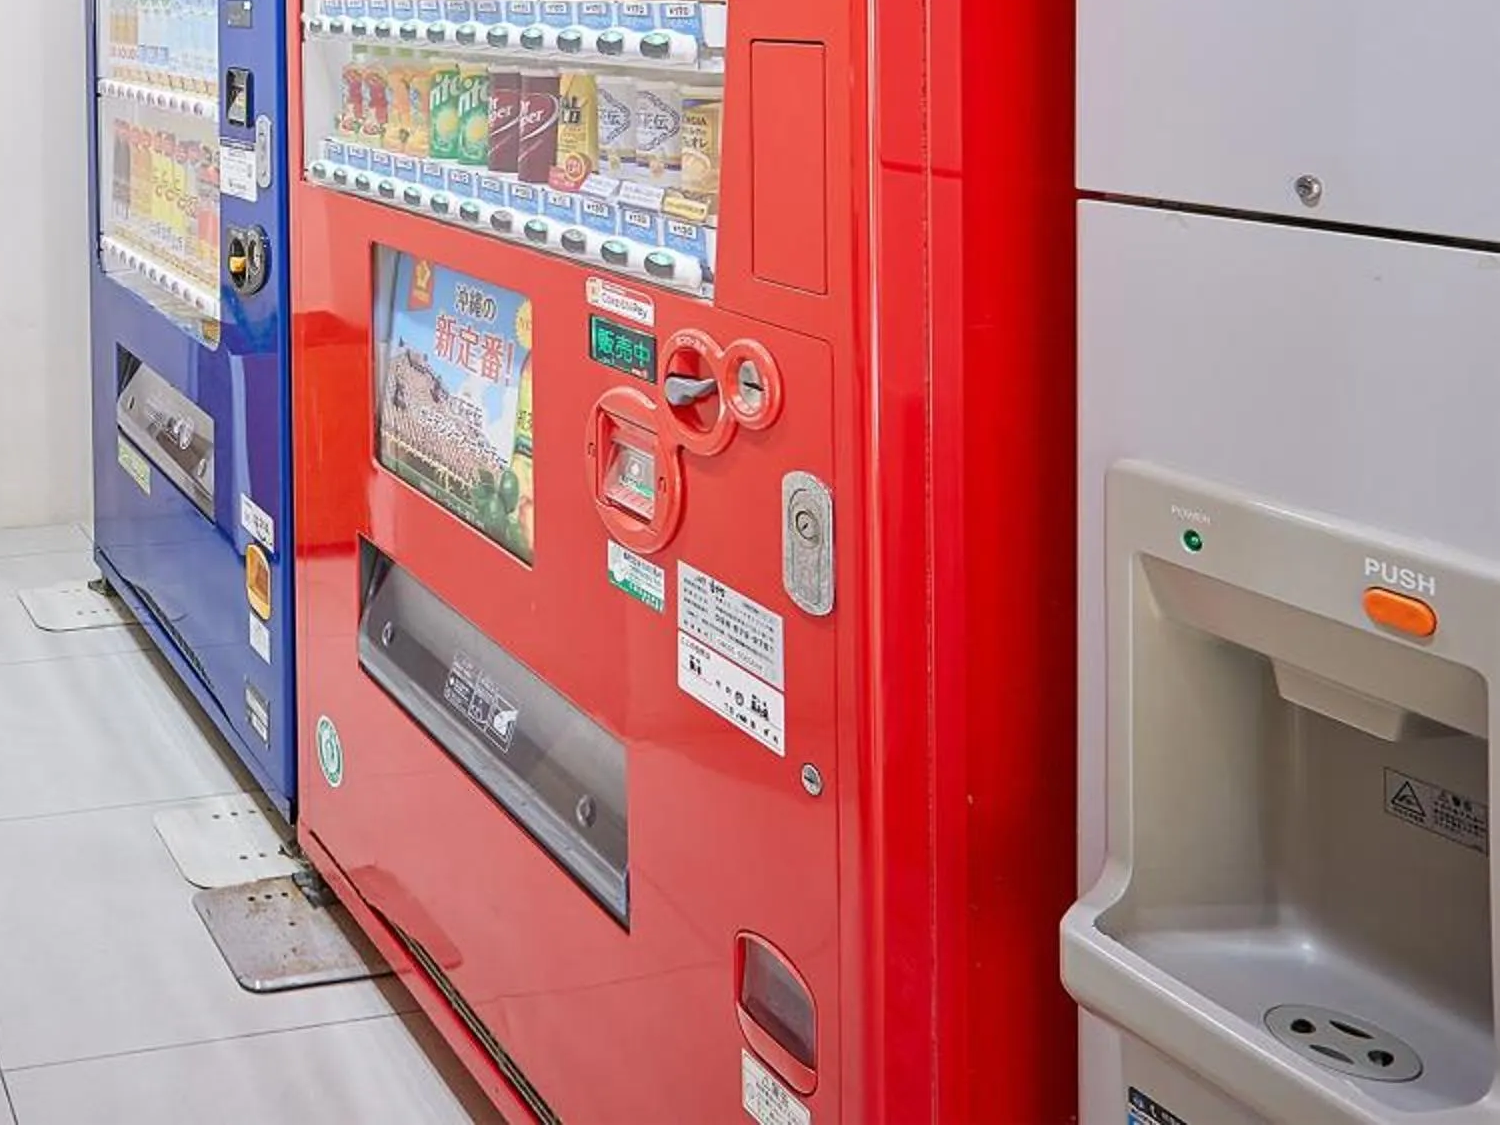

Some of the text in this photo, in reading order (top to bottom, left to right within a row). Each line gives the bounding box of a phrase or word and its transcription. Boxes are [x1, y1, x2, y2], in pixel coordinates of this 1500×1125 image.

[455, 282, 498, 321] 沖縄の
[435, 314, 515, 387] 新定番!
[599, 328, 650, 366] 販売中
[1171, 504, 1212, 525] POWER
[1364, 557, 1436, 596] PUSH
